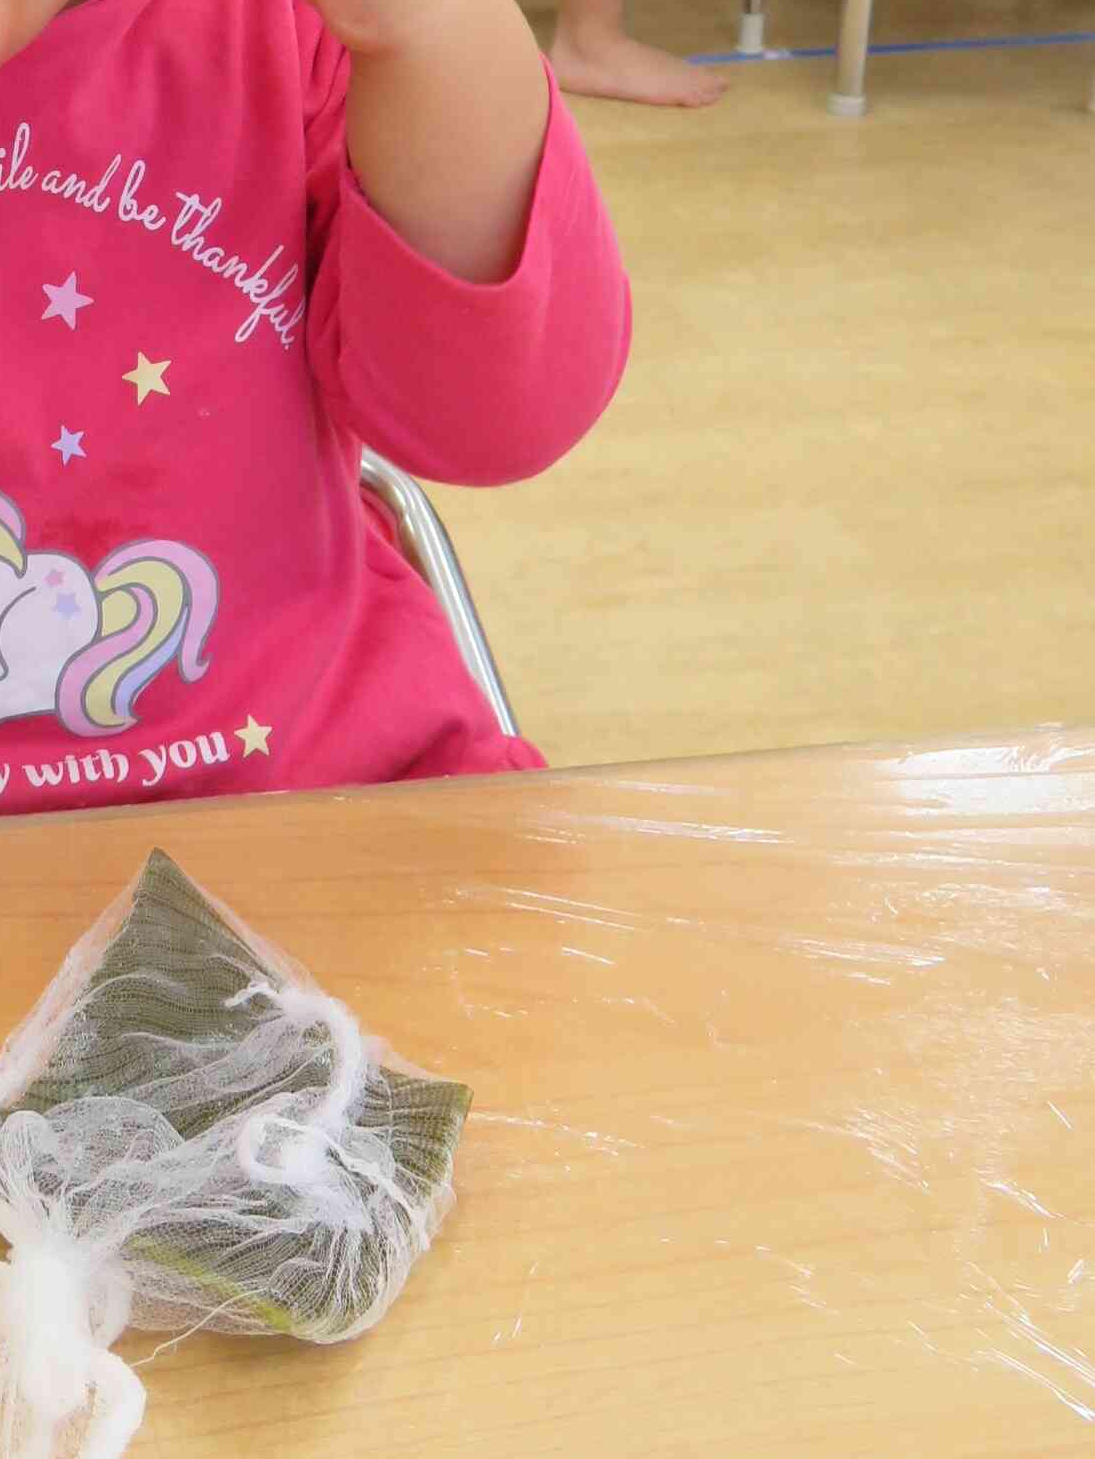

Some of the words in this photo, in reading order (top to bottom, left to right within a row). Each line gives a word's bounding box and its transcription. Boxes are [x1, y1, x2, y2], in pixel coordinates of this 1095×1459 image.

[41, 153, 122, 213] and
[118, 160, 167, 230] be
[22, 749, 129, 787] with
[139, 731, 230, 786] you
